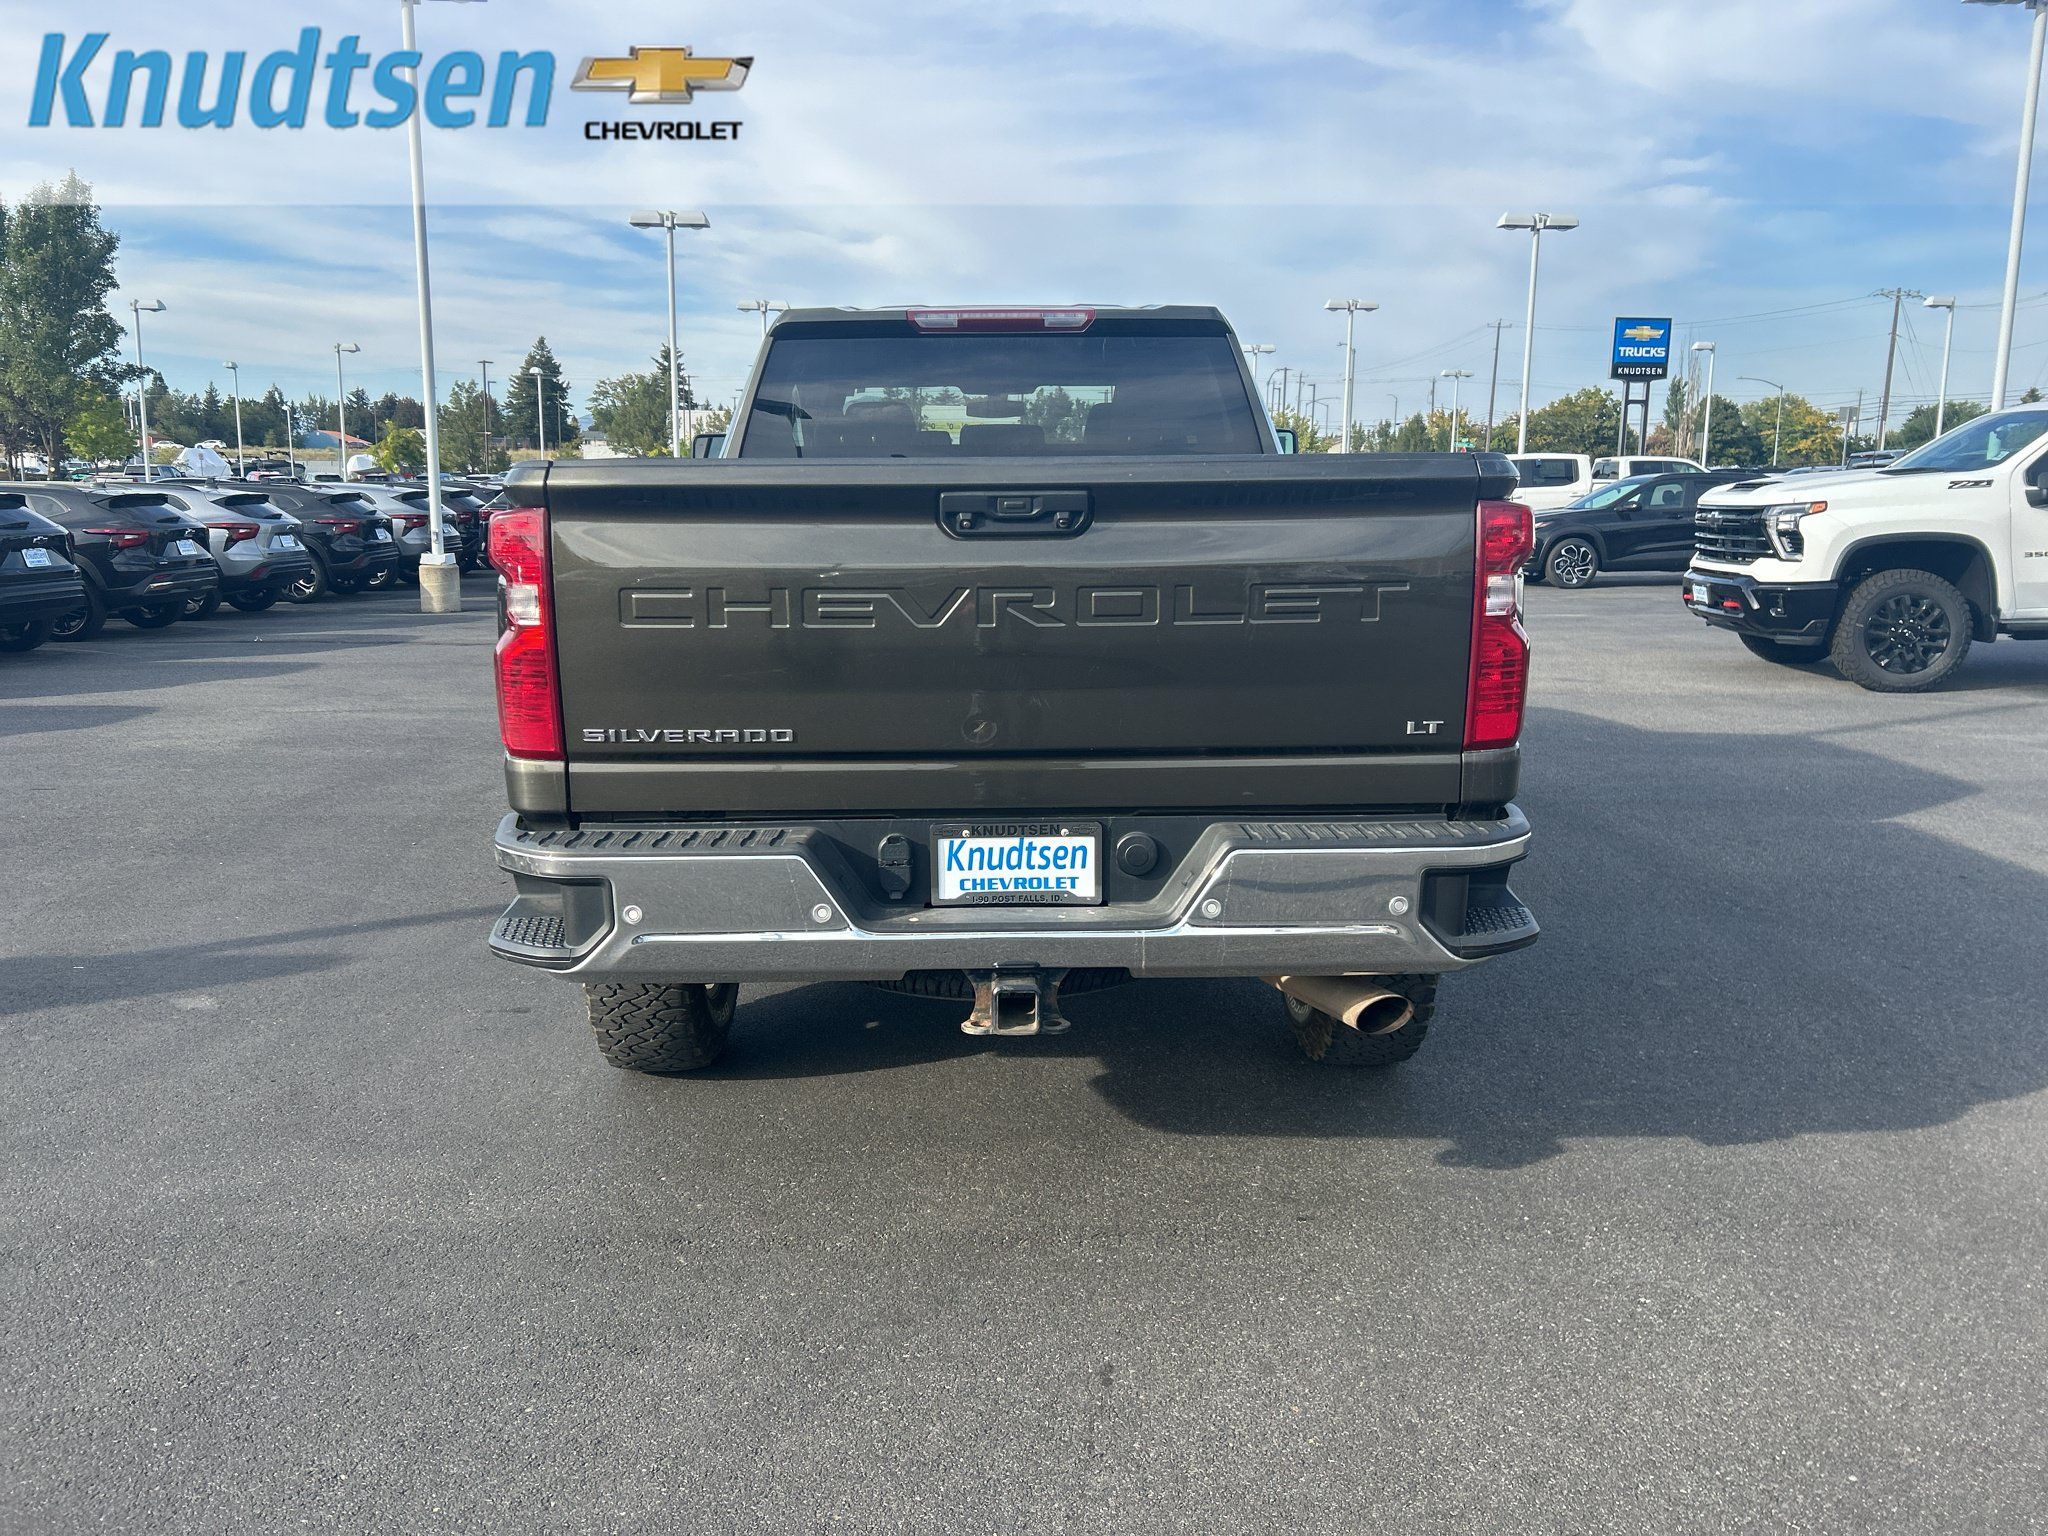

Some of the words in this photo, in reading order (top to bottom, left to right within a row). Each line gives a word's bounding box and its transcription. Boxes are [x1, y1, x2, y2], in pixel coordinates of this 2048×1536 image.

[1618, 347, 1665, 357] TRUCKS
[1617, 367, 1663, 375] KNUDTSEN
[618, 580, 1411, 629] CHEVROLET
[1406, 720, 1445, 735] LT
[582, 728, 795, 743] SILVERADO
[971, 824, 1061, 836] KNUDTSEN
[946, 837, 1088, 872] Knudtsen
[959, 876, 1080, 891] CHEVROLET
[991, 895, 1016, 904] POST
